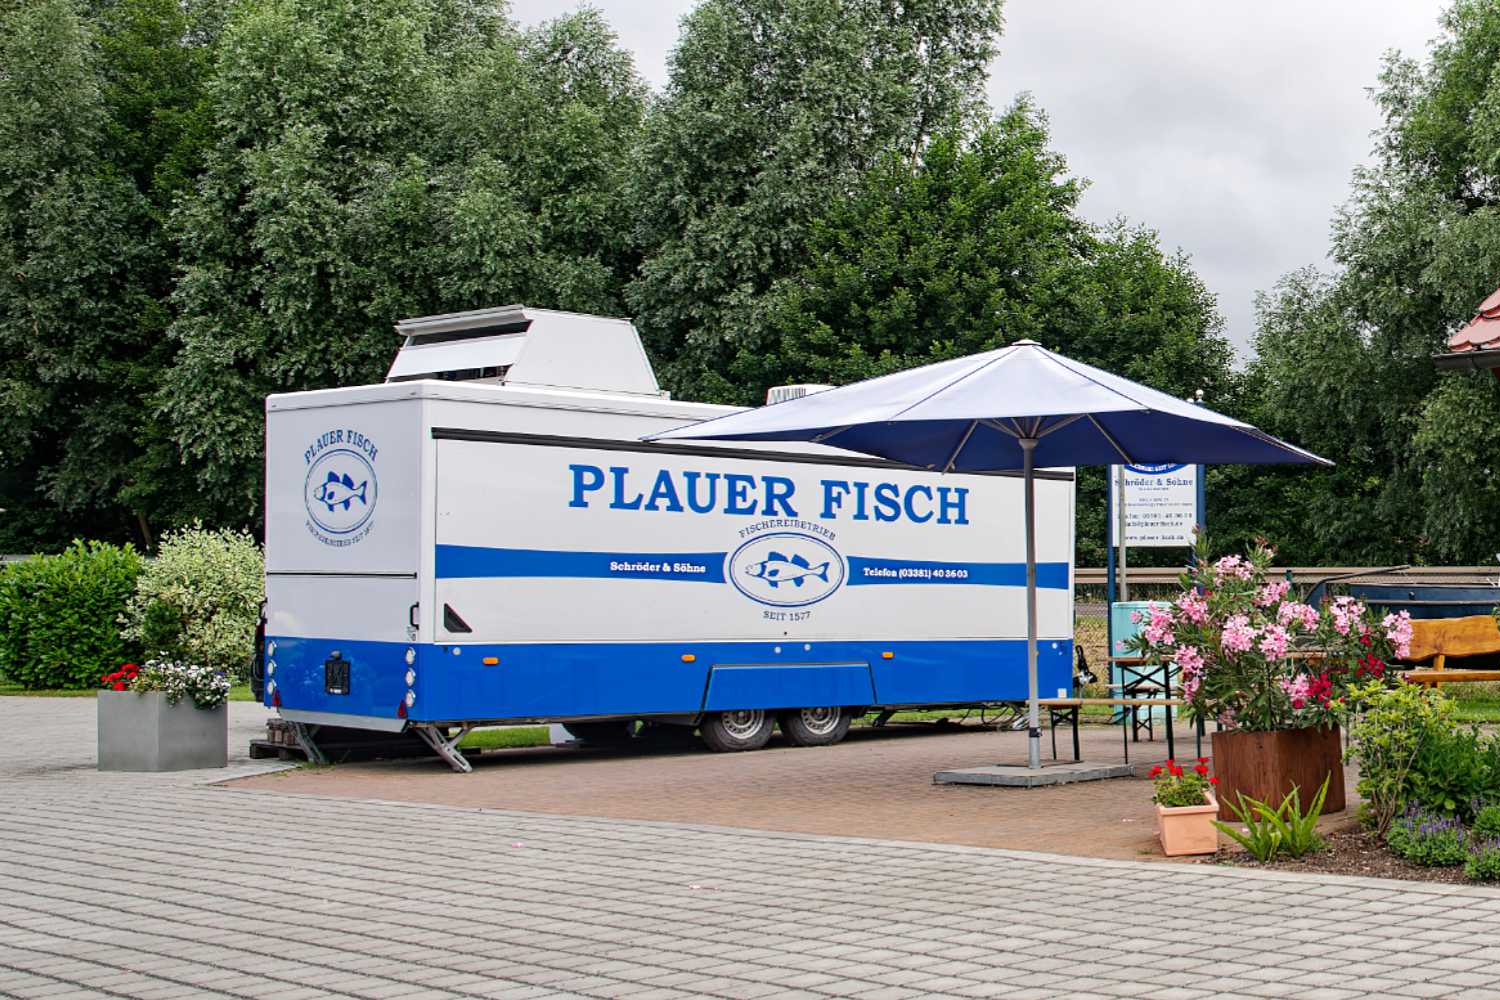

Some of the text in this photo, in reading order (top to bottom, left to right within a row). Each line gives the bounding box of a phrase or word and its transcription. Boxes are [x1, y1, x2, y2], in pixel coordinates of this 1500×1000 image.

[304, 429, 378, 464] PLAUER FISCH
[568, 464, 970, 525] PLAUER FISCH
[738, 519, 836, 541] FISCHEREIBETRIEB
[610, 561, 706, 573] Schröder & Söhne
[863, 567, 897, 577] Telefon
[898, 567, 931, 579] (03381)
[763, 610, 812, 621] SEIT 1577
